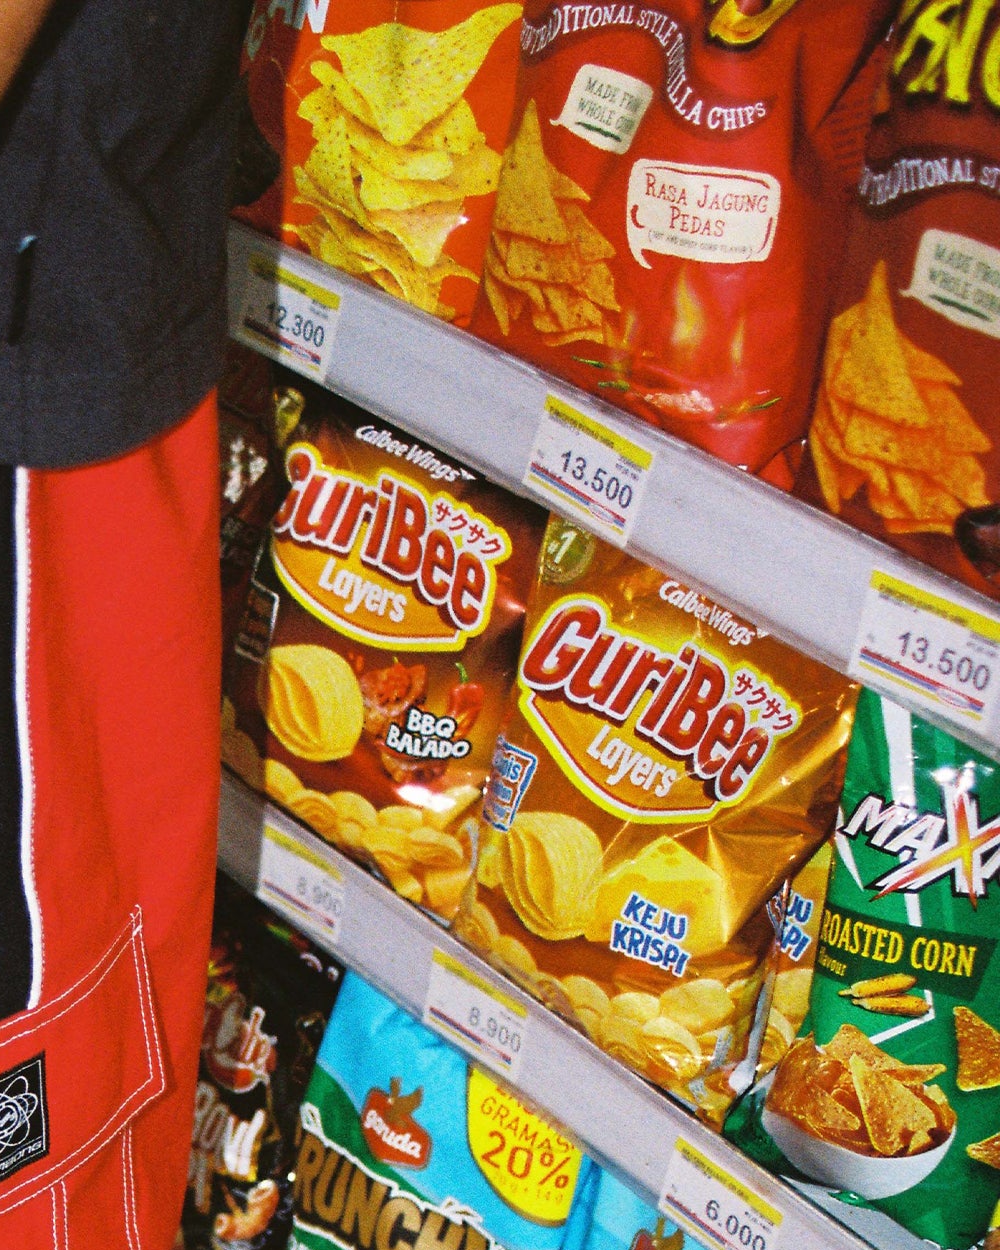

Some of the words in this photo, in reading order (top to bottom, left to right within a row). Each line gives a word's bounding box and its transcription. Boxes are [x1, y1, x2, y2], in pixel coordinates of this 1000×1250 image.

[636, 9, 679, 47] STYLE
[707, 102, 767, 131] CHIPS
[645, 173, 688, 207] RASA
[697, 184, 770, 214] JAGUNG
[669, 205, 727, 238] PEDAS
[267, 302, 326, 349] 12.300
[354, 424, 408, 461] Calbee
[405, 444, 462, 484] Wings
[560, 449, 634, 510] 13.500
[275, 448, 489, 630] uriBee
[318, 556, 408, 623] Layers
[659, 579, 712, 623] Calbee
[708, 604, 757, 647] Wings
[898, 631, 991, 692] 13.500
[385, 723, 471, 759] BALADO
[407, 708, 457, 739] BBQ
[586, 725, 677, 798] Layers
[623, 893, 688, 940] KEJU
[820, 908, 905, 964] ROASTED
[910, 936, 978, 979] CORN
[611, 922, 690, 976] KRISPI
[468, 1005, 522, 1053] 8.900
[481, 1129, 572, 1190] 20%
